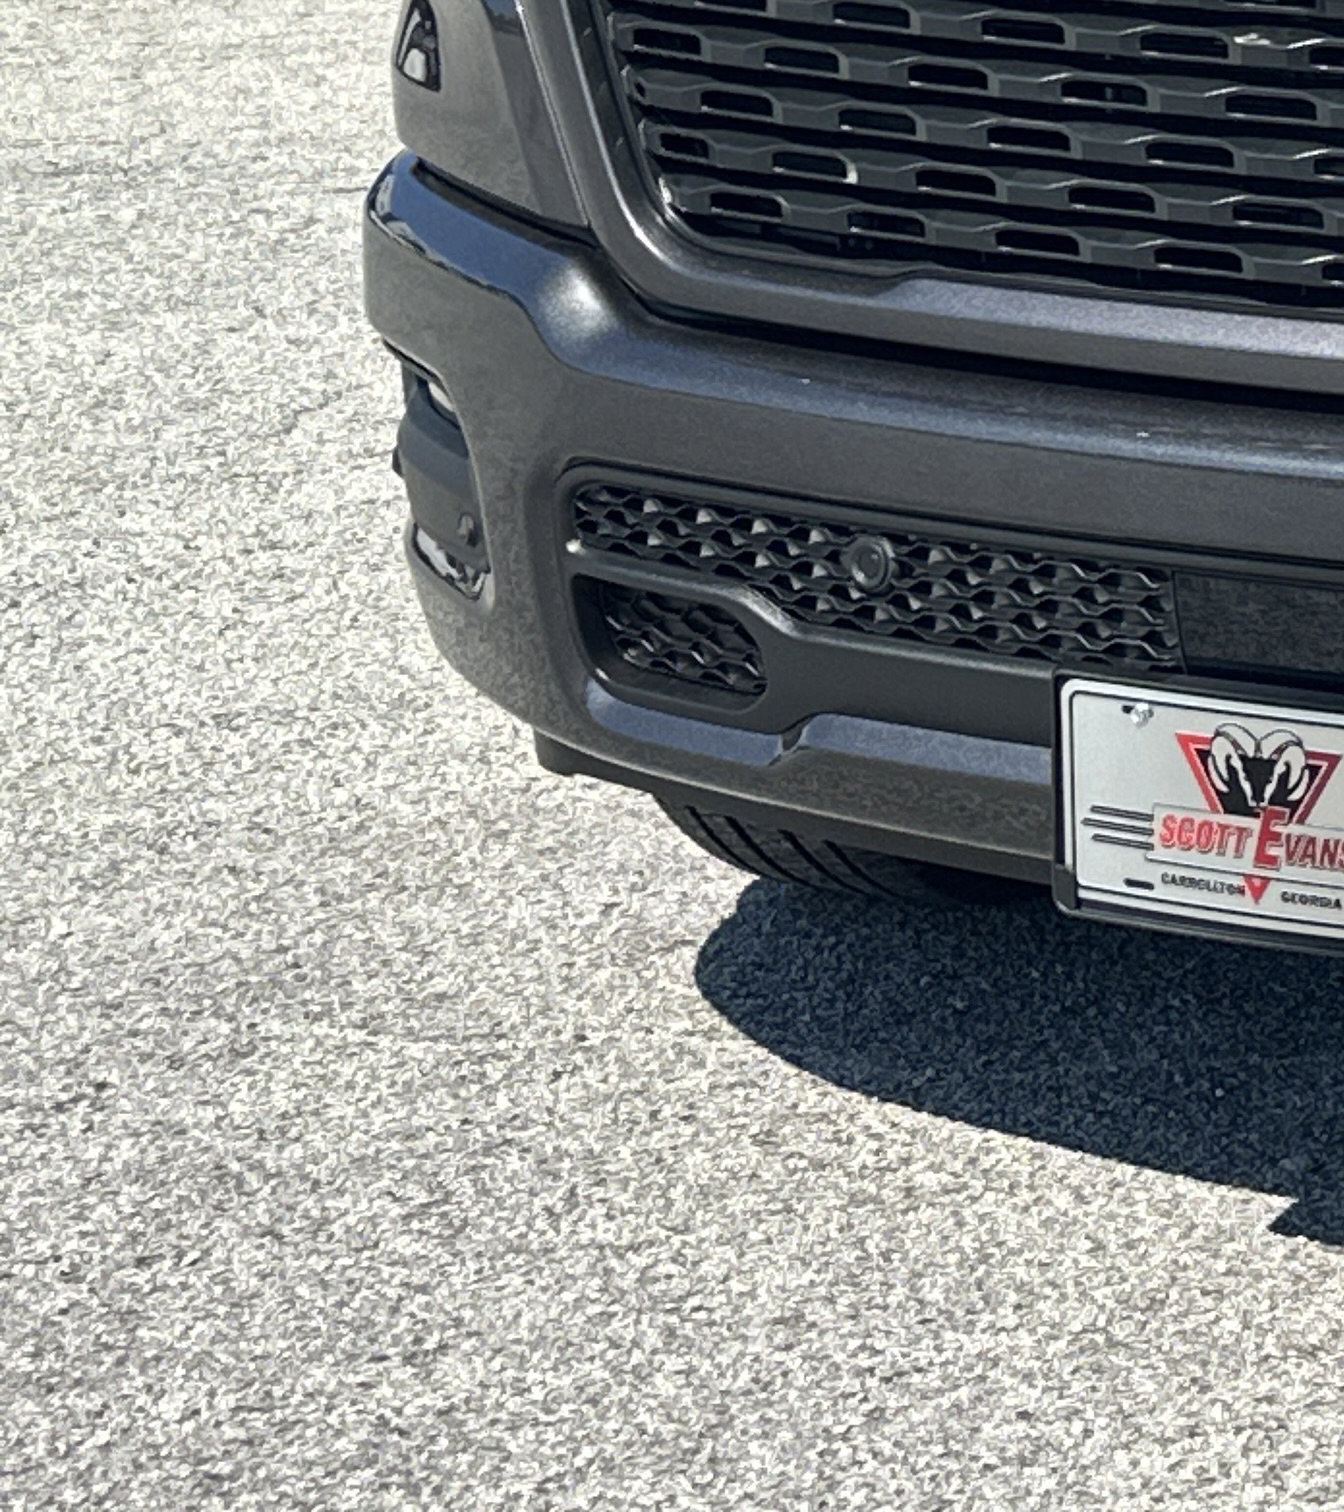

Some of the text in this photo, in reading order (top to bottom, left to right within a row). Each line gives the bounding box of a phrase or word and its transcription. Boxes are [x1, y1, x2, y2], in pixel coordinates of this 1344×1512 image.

[1159, 813, 1253, 859] SCOTT
[1161, 873, 1343, 911] CARROLLTON GEORGIA
